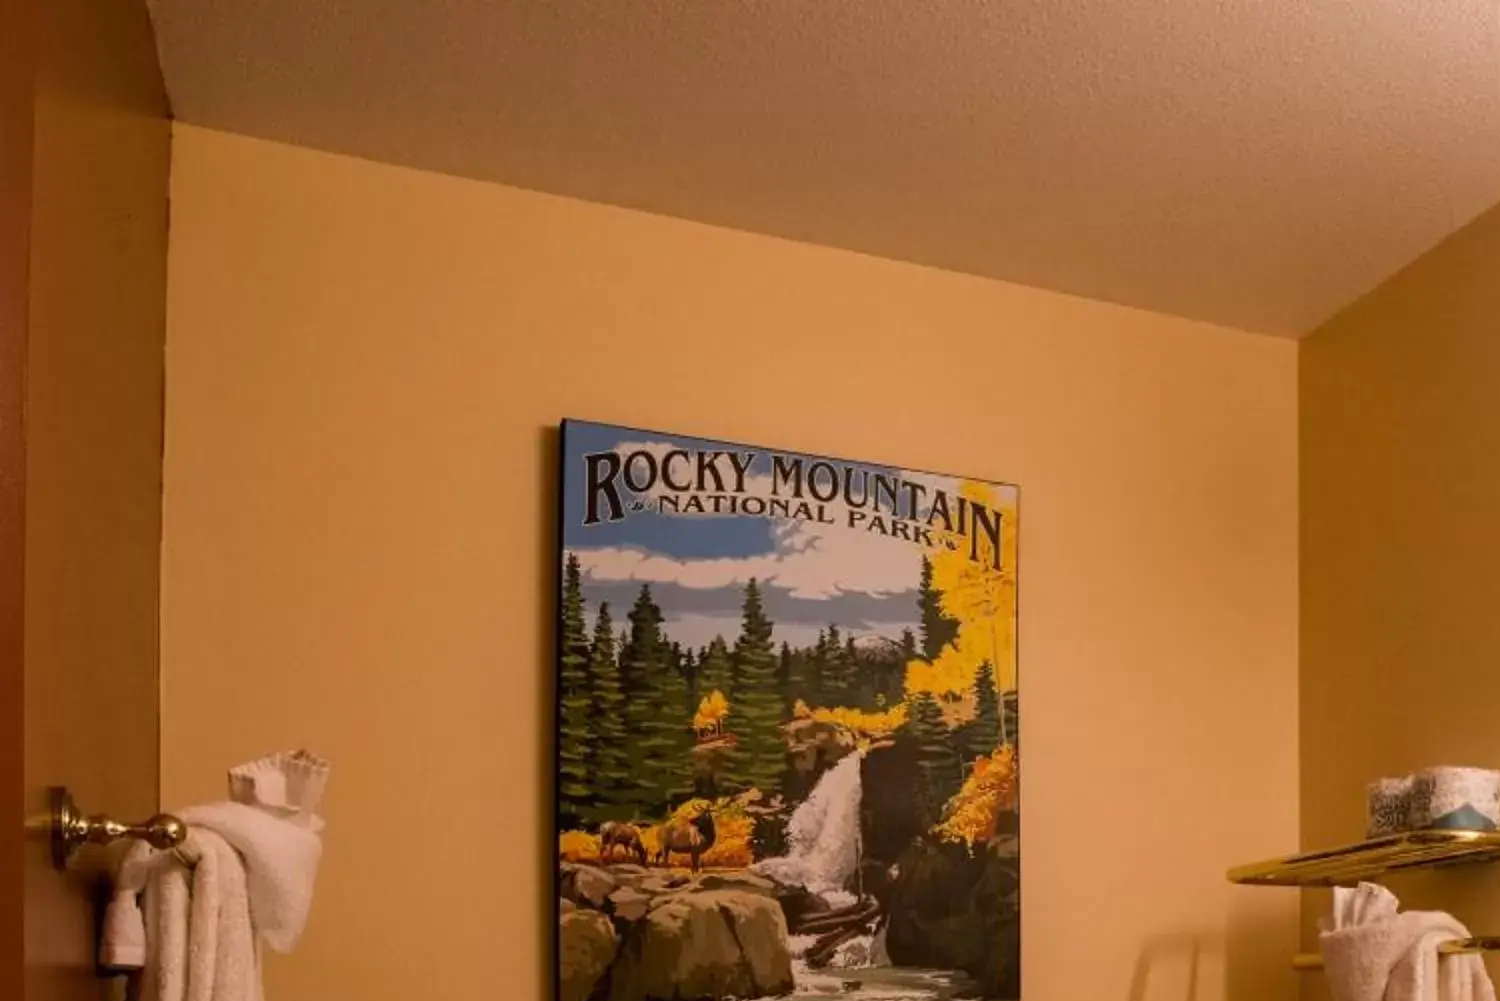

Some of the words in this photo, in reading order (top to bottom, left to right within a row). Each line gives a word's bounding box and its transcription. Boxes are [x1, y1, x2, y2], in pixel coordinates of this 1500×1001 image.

[582, 449, 755, 527] ROCKY
[771, 455, 1004, 571] MOUNTAIN
[657, 493, 835, 526] NATIONAL
[847, 510, 934, 548] PARK
